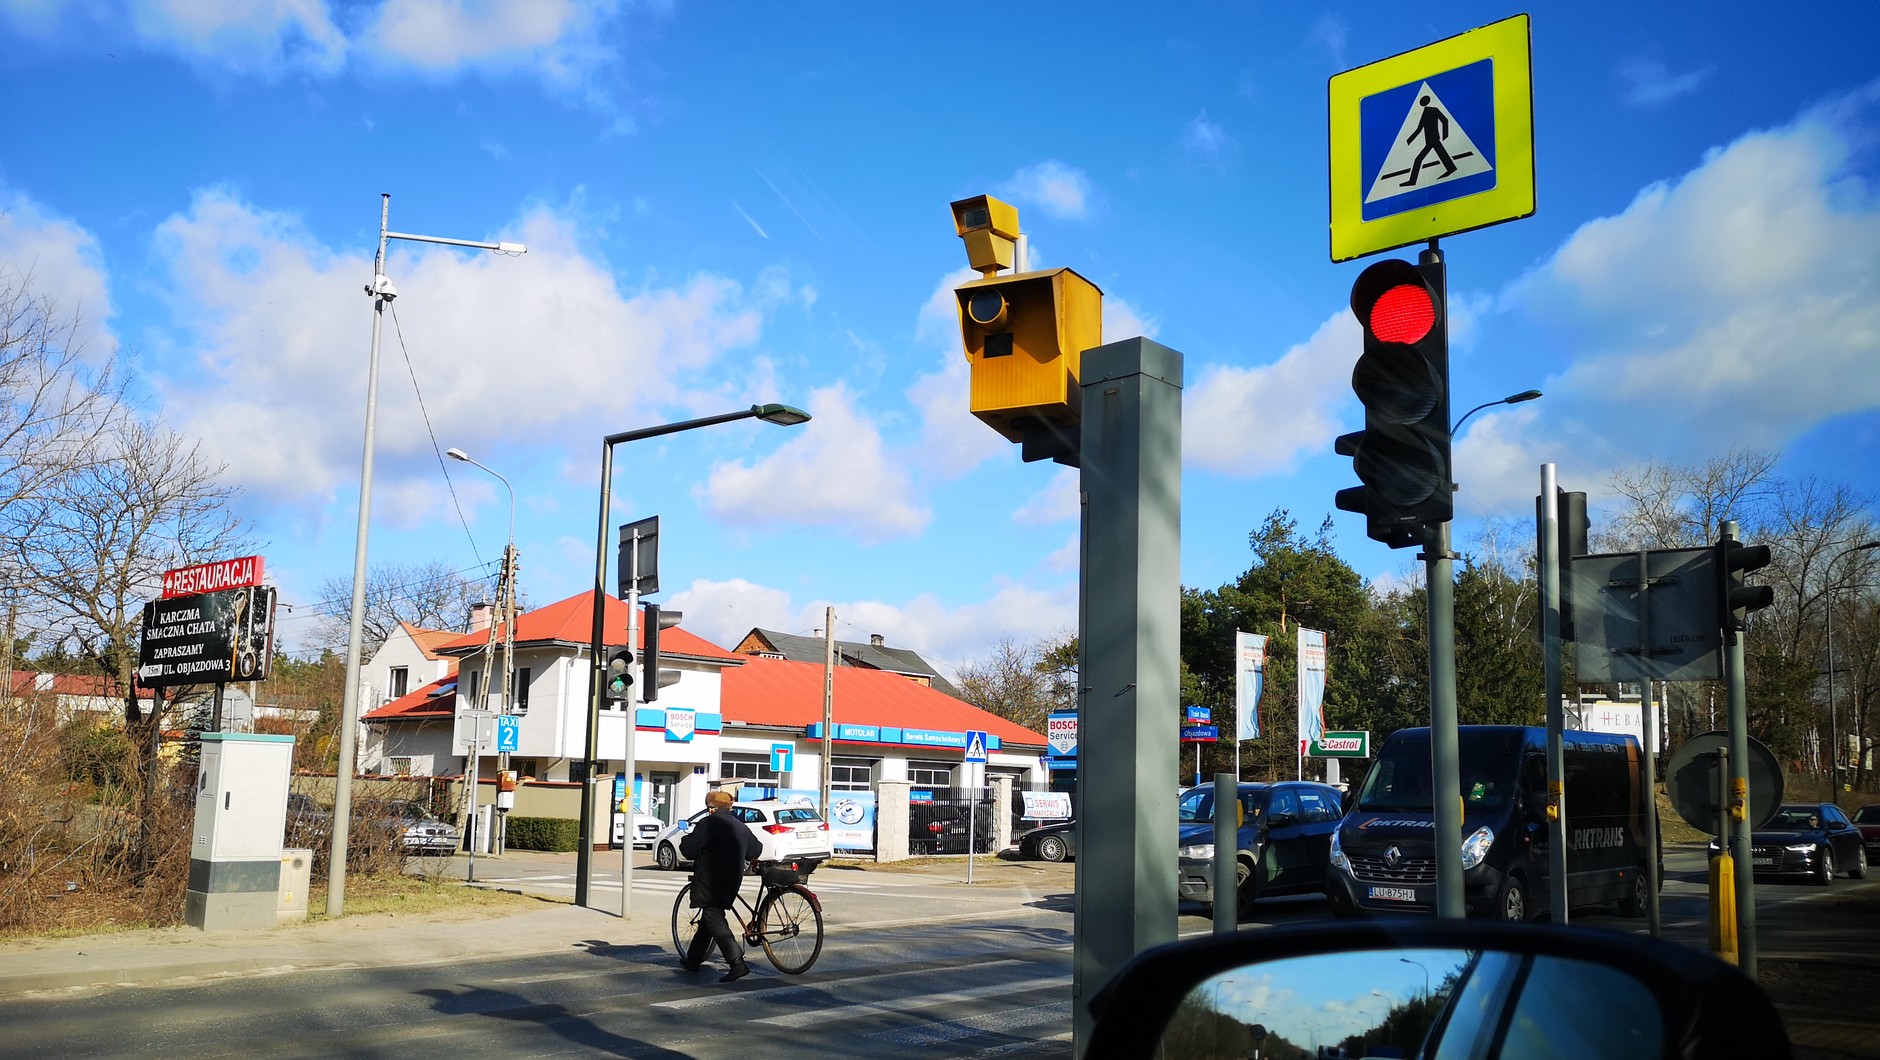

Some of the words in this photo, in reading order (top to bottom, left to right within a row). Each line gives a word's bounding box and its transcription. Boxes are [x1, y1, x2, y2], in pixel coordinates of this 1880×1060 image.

[173, 559, 253, 595] RESTAURACJA
[160, 608, 200, 624] KARCZMA
[146, 624, 184, 641] SMACZNA
[187, 620, 216, 635] CHATA
[153, 643, 205, 659] ZAPRASZAMY
[163, 664, 175, 675] UL.
[177, 659, 224, 674] OBJAZDOWA
[225, 660, 231, 671] 3
[500, 717, 518, 728] TAXI
[670, 713, 693, 721] BOSCH
[670, 721, 693, 729] Service
[1050, 721, 1077, 730] BOSCH
[503, 727, 514, 745] 2
[845, 728, 875, 738] MOTOLAB
[905, 732, 924, 741] Serwis
[923, 734, 961, 745] Samochodowy
[1184, 730, 1212, 738] Objazdowa
[1328, 739, 1358, 749] Castrol
[1034, 799, 1060, 809] SERWIS
[1367, 820, 1436, 828] RKTRAN
[1574, 827, 1624, 850] RKTRANS
[1374, 888, 1385, 896] LU
[1387, 888, 1414, 899] 875HJ
